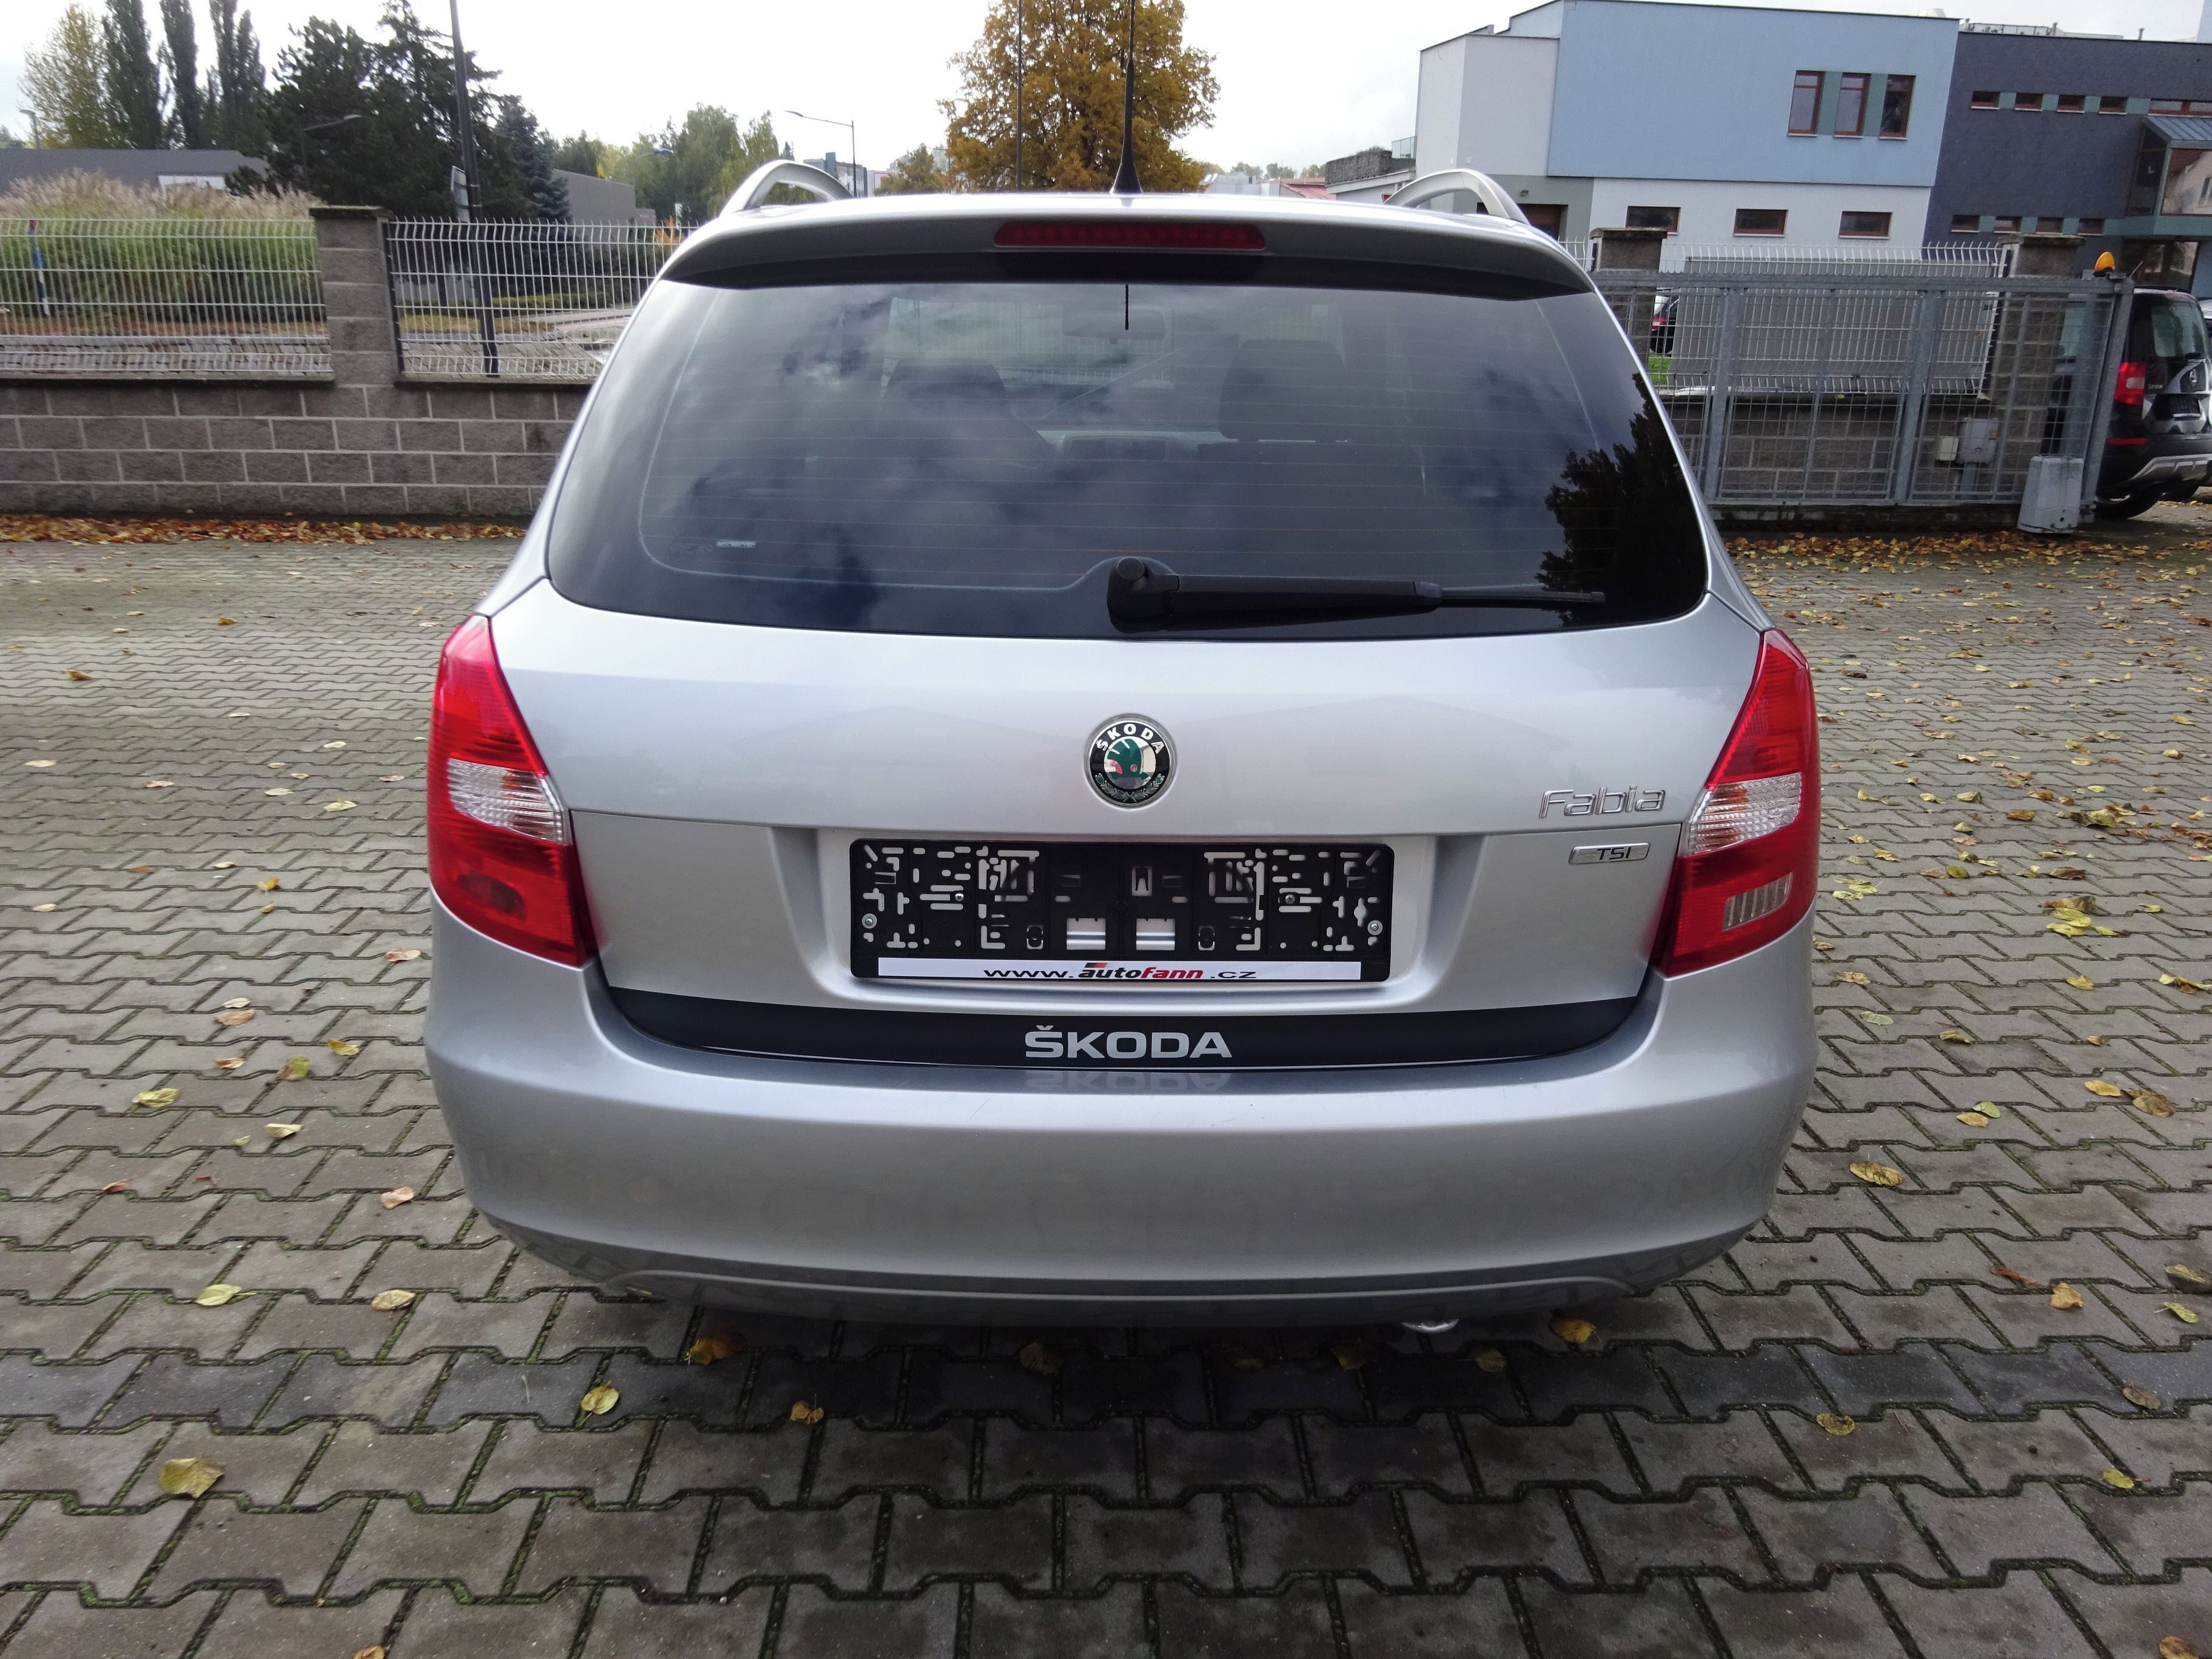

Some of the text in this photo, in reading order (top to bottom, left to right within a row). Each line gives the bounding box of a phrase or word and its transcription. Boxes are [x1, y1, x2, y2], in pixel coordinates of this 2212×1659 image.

[1539, 785, 1665, 819] Fabia
[1597, 846, 1631, 860] TSI
[1025, 1025, 1232, 1058] ŠKODA
